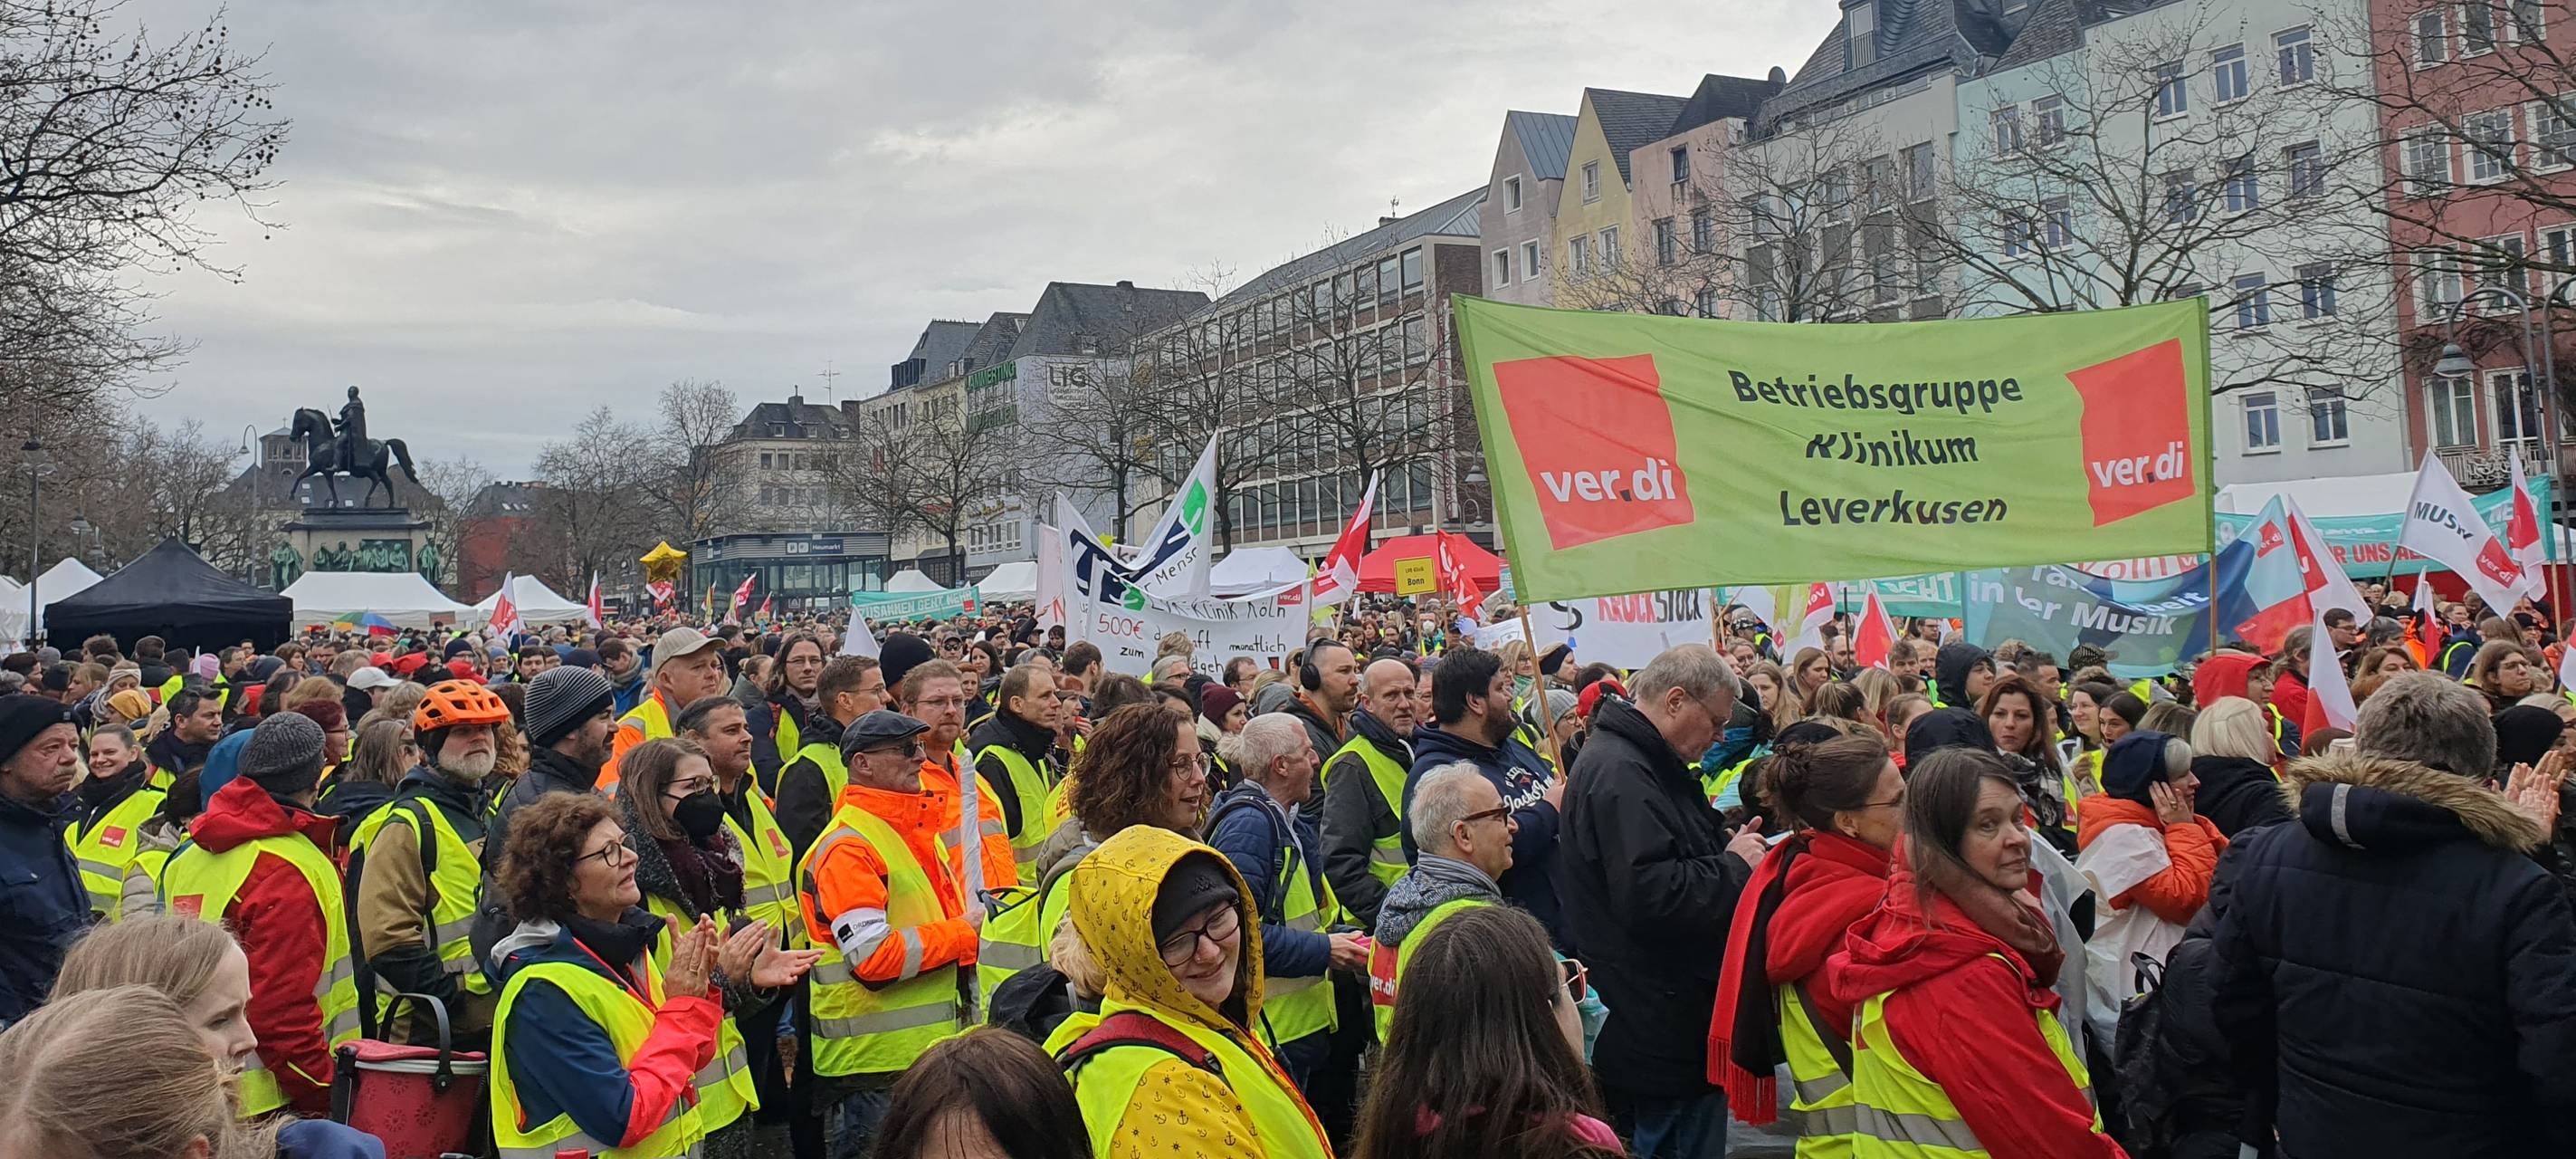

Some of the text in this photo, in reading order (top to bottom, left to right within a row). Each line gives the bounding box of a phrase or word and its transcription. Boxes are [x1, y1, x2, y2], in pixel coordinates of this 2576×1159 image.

[1727, 369, 2024, 416] Betriebsgruppe
[1805, 429, 1980, 467] Klinikum
[2092, 440, 2184, 488] ver.di
[1540, 456, 1676, 503] ver.di
[1779, 489, 2008, 526] Leverkusen
[2353, 542, 2393, 563] UNS
[1407, 578, 1425, 586] Bonn
[917, 596, 944, 610] GEHT
[1279, 593, 1301, 602] ver.di
[1970, 573, 2005, 603] in
[2070, 601, 2178, 635] Musik
[1097, 613, 1145, 640] 500€
[1120, 647, 1145, 659] zum
[1229, 634, 1287, 653] monatlich
[1369, 975, 1396, 997] ver.di
